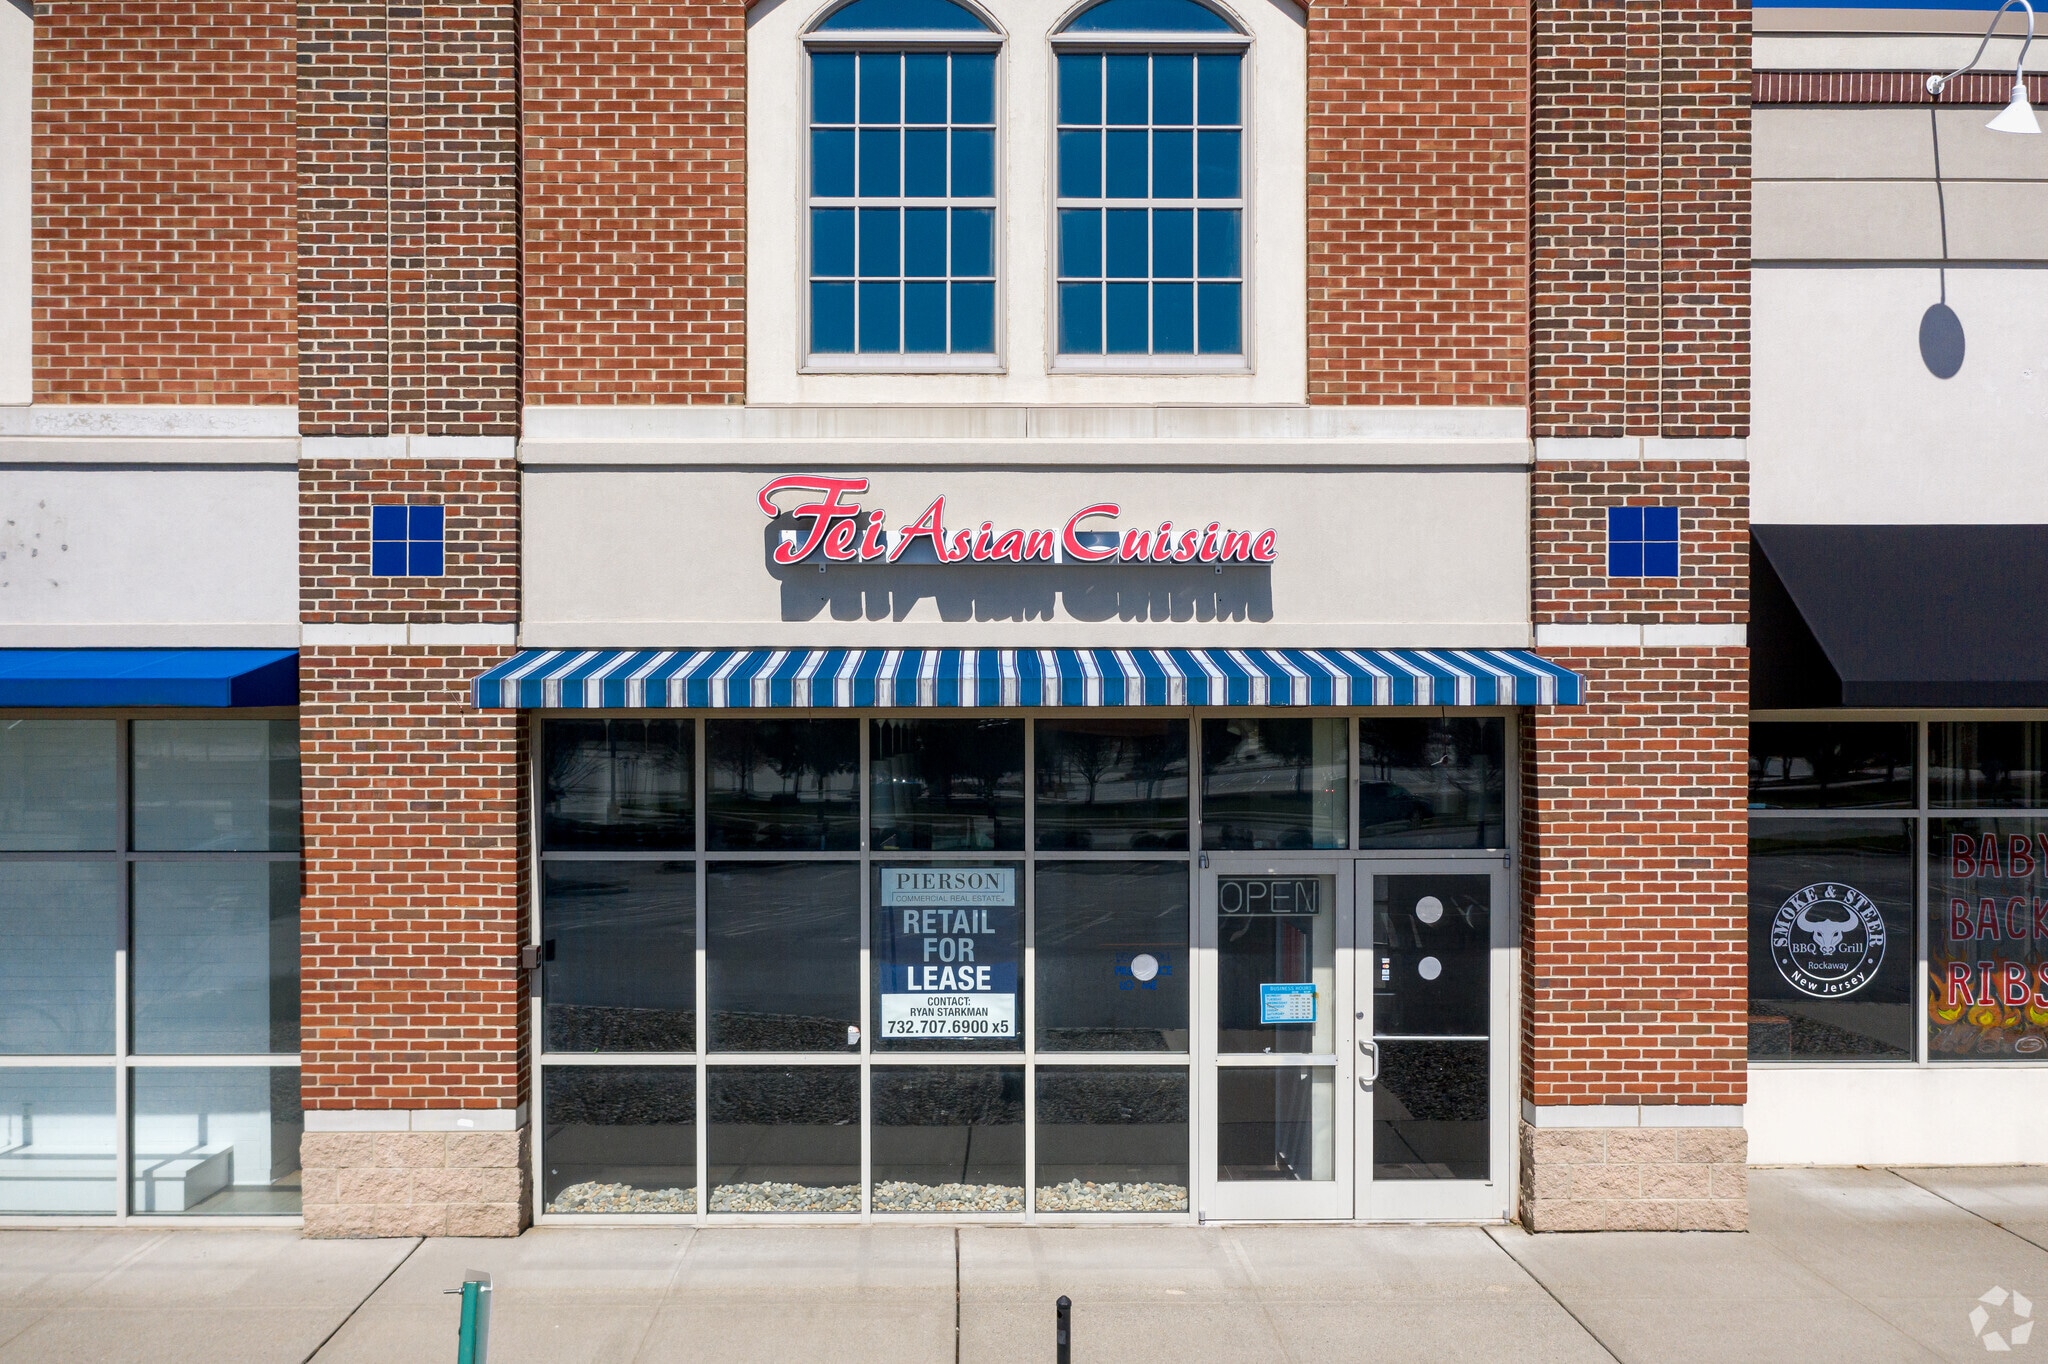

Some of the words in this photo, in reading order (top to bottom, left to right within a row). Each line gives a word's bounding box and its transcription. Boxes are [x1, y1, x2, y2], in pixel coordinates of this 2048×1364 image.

[756, 474, 886, 566] Fei
[888, 494, 1055, 564] Asian
[1062, 502, 1279, 564] Cuisine
[896, 872, 1001, 890] PIERSON
[896, 895, 947, 903] COMMERCIAL
[950, 895, 970, 903] REAL
[1220, 881, 1317, 913] OPEN
[903, 909, 996, 934] RETAIL
[1773, 886, 1819, 948] SMOKE
[1824, 885, 1837, 899] &
[1843, 889, 1884, 948] STEER
[923, 937, 975, 963] FOR
[1792, 943, 1817, 955] BBQ
[1838, 942, 1864, 953] Grill
[1808, 961, 1849, 971] Rockaway
[907, 966, 992, 991] LEASE
[1791, 970, 1818, 991] New
[1823, 971, 1865, 993] Jersey
[1948, 961, 2048, 1009] RIBS
[910, 1007, 936, 1017] RYAN
[937, 1007, 988, 1017] STARKMAN
[927, 996, 971, 1006] CONTACT:
[888, 1020, 988, 1034] 732.707.6900
[992, 1020, 1009, 1034] x5
